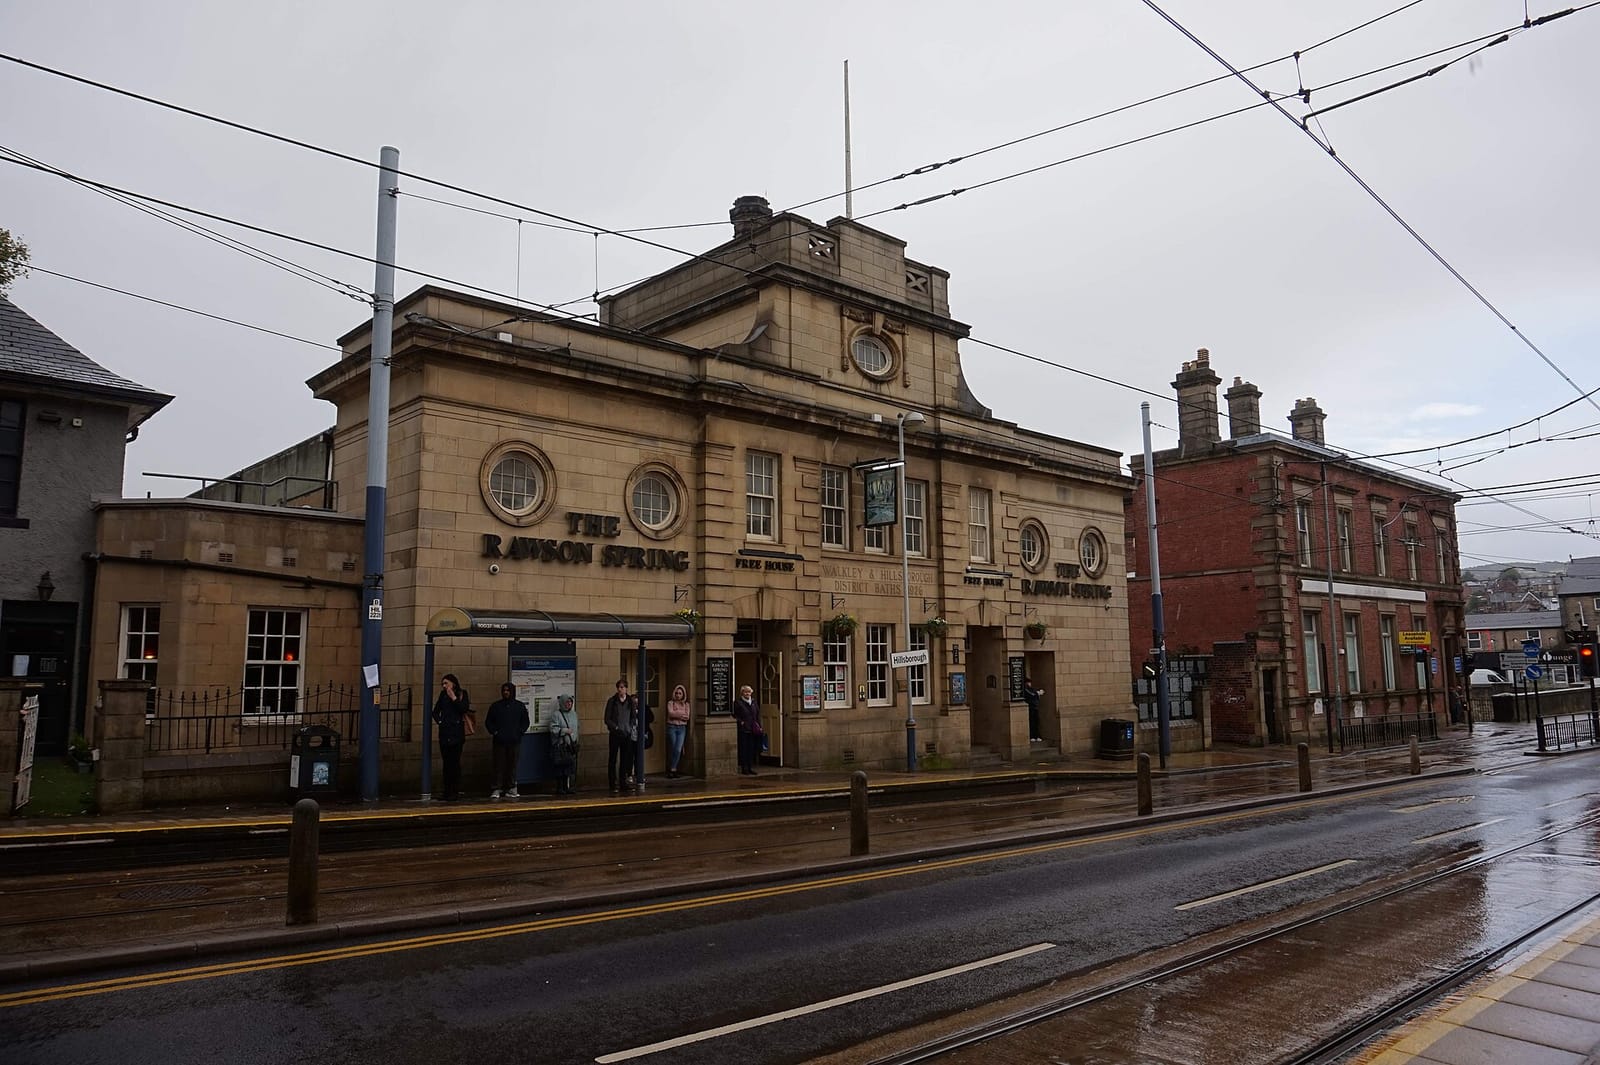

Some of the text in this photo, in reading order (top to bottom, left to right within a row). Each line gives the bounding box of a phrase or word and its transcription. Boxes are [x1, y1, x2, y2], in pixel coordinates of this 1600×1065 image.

[565, 512, 621, 537] THE
[481, 534, 690, 572] RAWSON SPRING
[735, 558, 795, 572] FREE HOUSE
[1055, 562, 1081, 579] THE
[822, 565, 934, 583] WALKLEY & HILLSROUGH
[963, 576, 1005, 587] FREE HOUSE
[834, 580, 869, 593] DISTRICT
[874, 583, 901, 596] BATHS
[1021, 579, 1112, 600] RAWSON SPRING
[893, 652, 927, 664] Hillsborough
